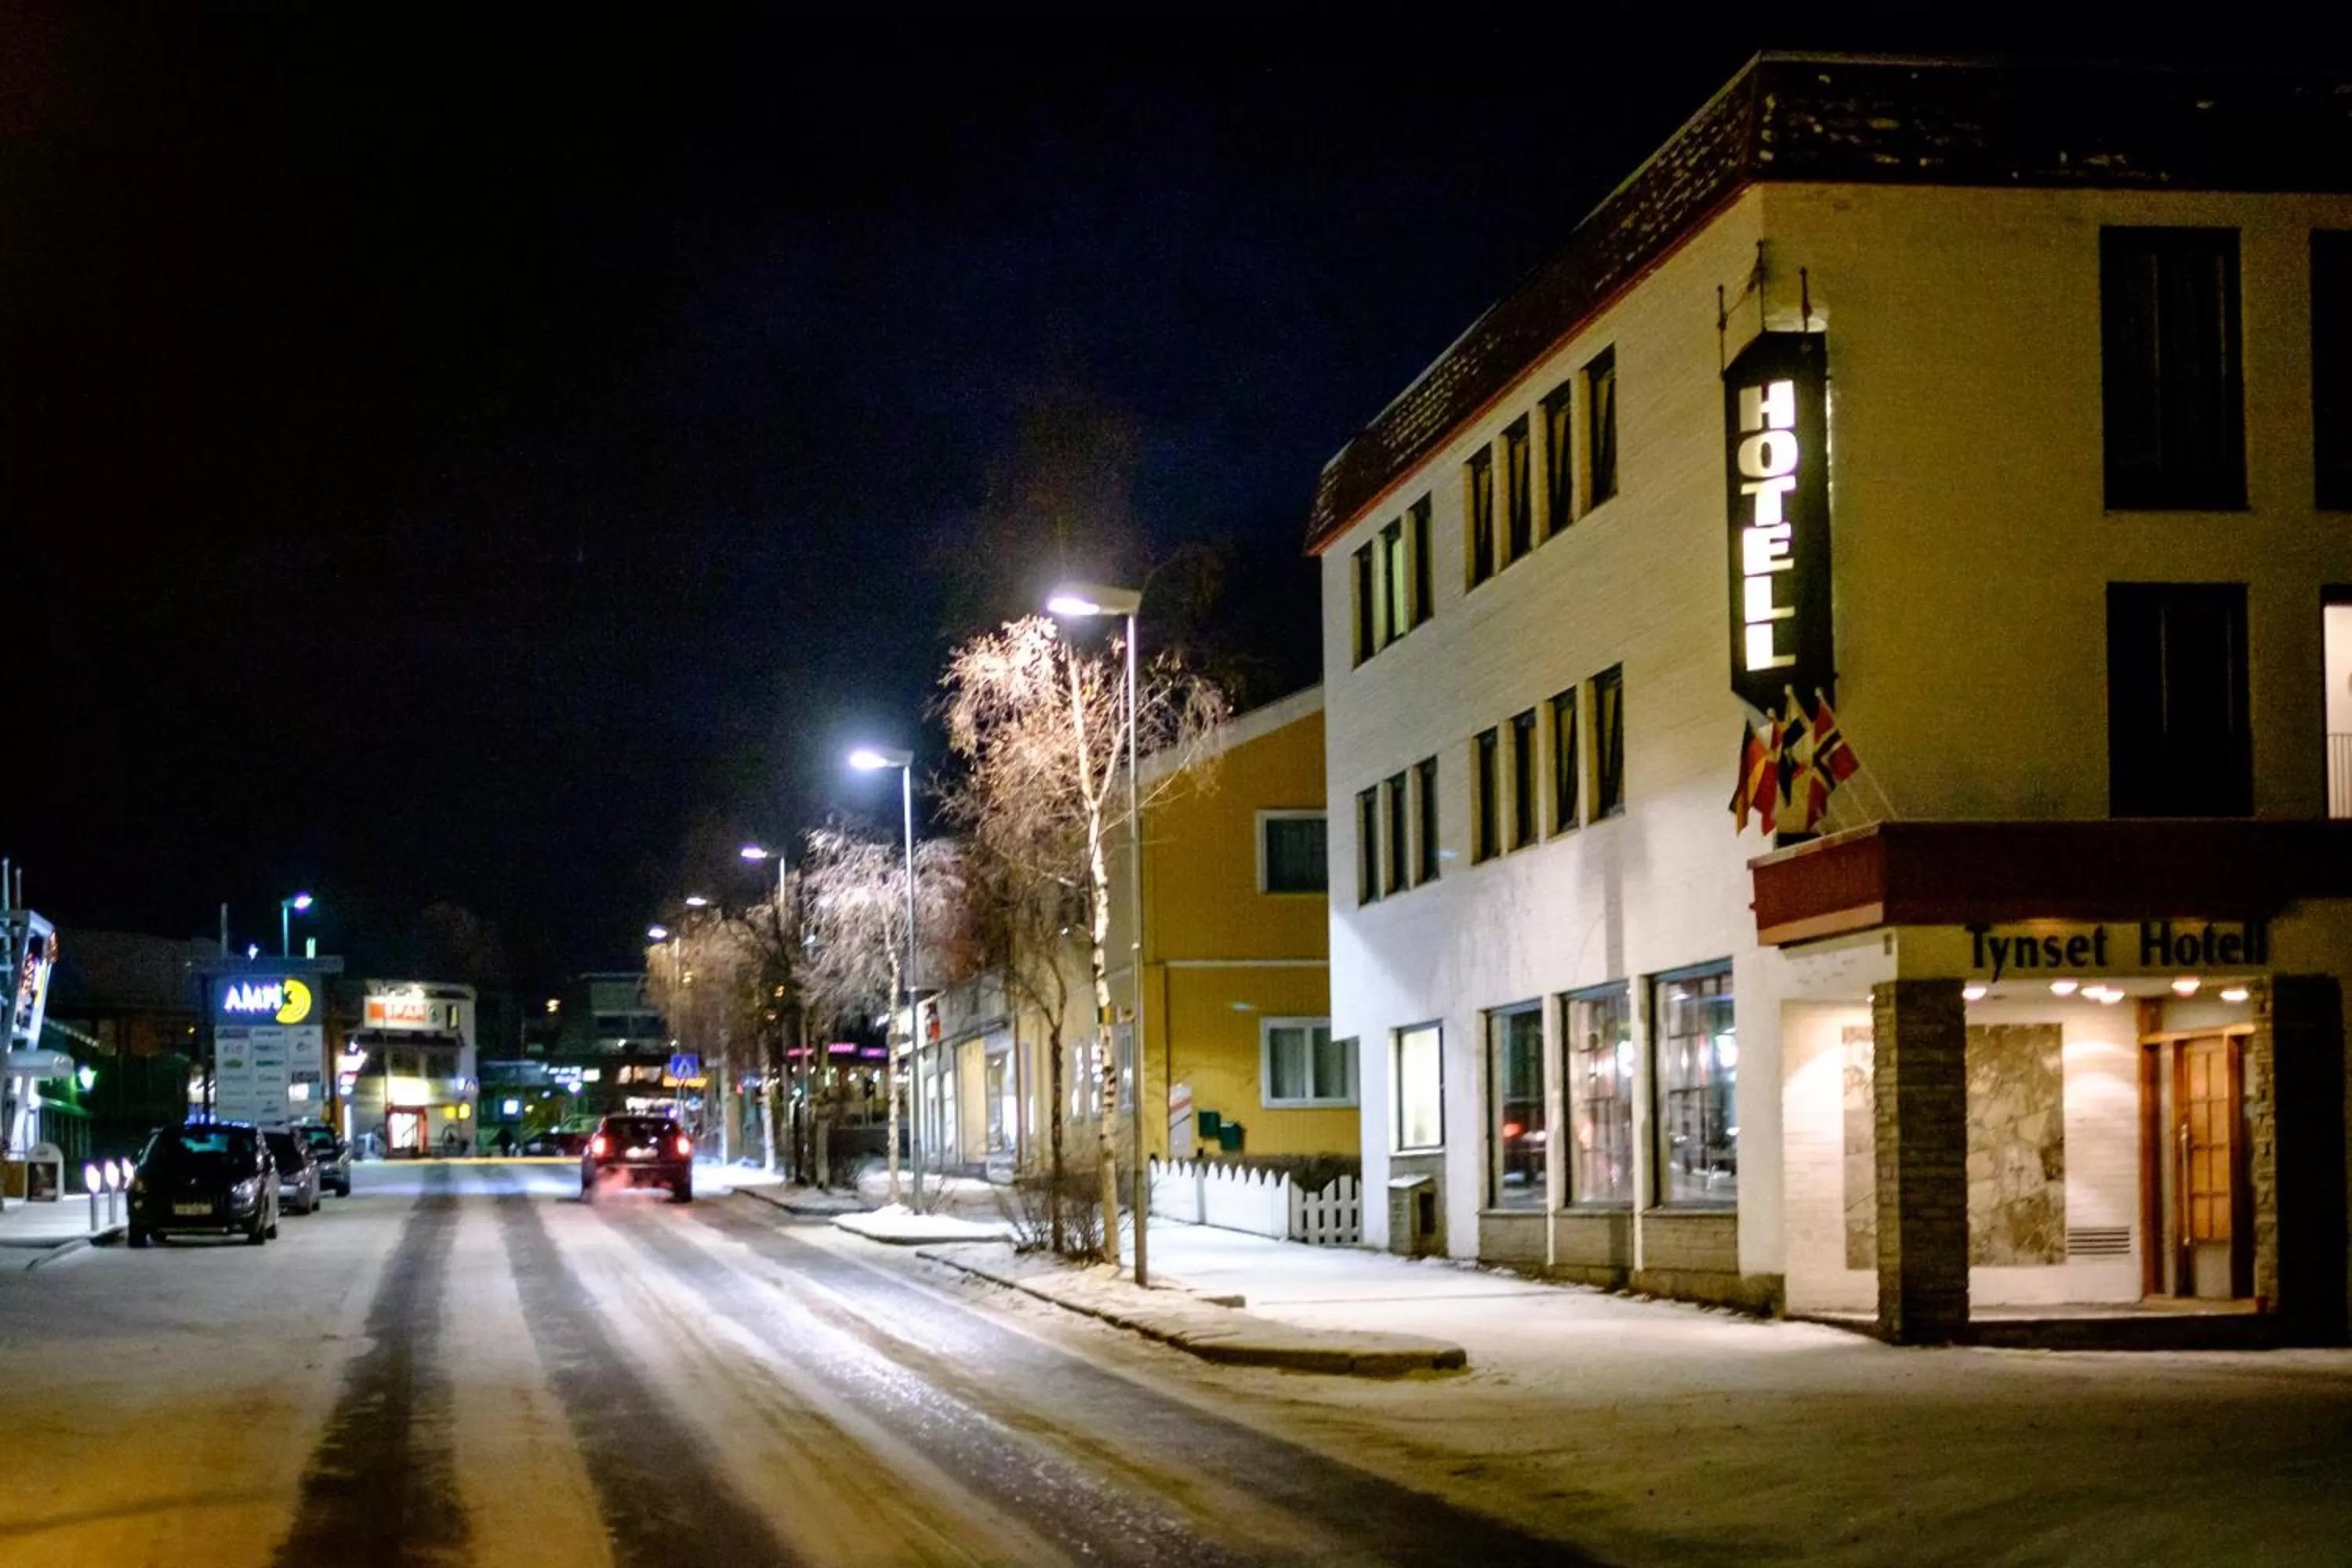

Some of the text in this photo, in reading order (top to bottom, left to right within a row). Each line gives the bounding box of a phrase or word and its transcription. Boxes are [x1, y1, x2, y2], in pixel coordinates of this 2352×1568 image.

[1737, 379, 1798, 672] HOTELL
[1965, 918, 2269, 983] Tynset Hotell
